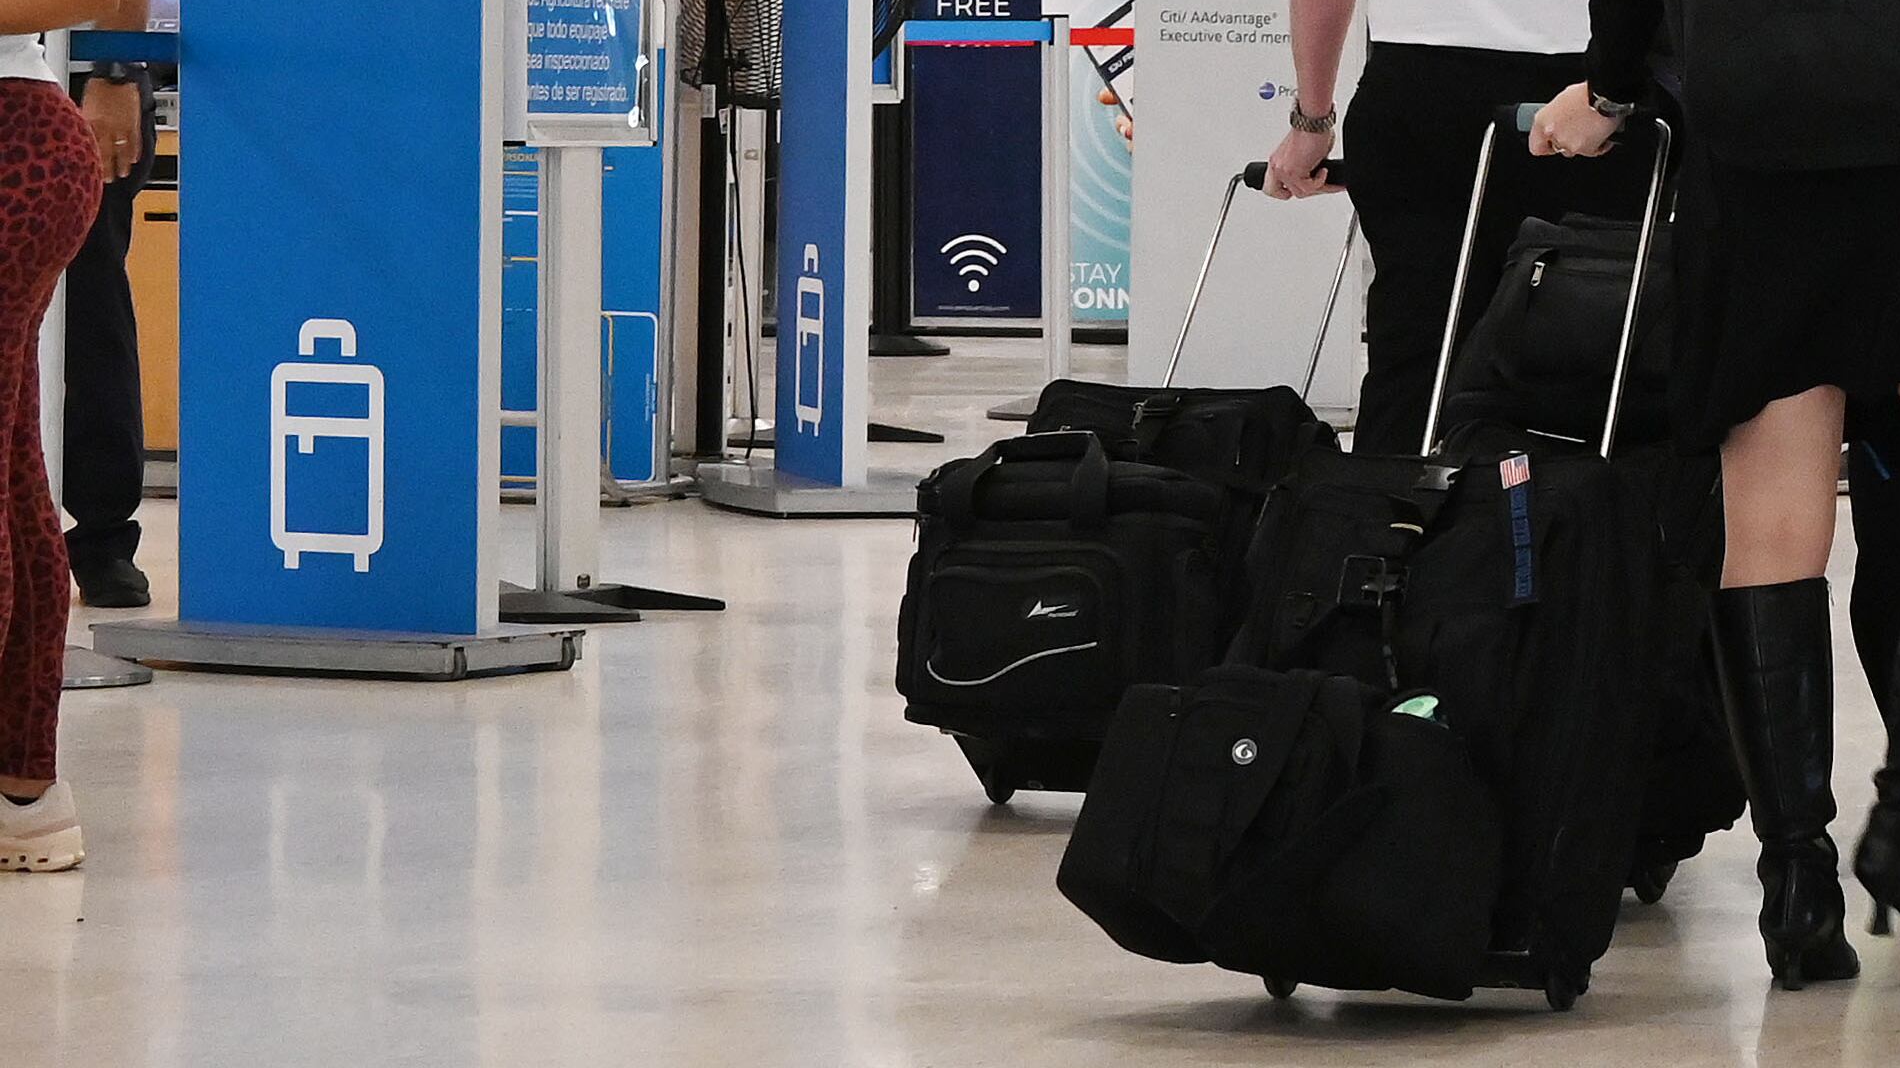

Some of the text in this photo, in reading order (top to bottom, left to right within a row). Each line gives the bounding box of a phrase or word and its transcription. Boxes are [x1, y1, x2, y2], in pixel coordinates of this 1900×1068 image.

[547, 19, 567, 38] todo
[1160, 29, 1222, 42] Executive
[1226, 30, 1257, 43] Card
[528, 82, 550, 101] ntes
[551, 81, 564, 101] de
[565, 86, 581, 101] ser
[1071, 262, 1122, 283] TAY
[1071, 287, 1130, 309] ONN
